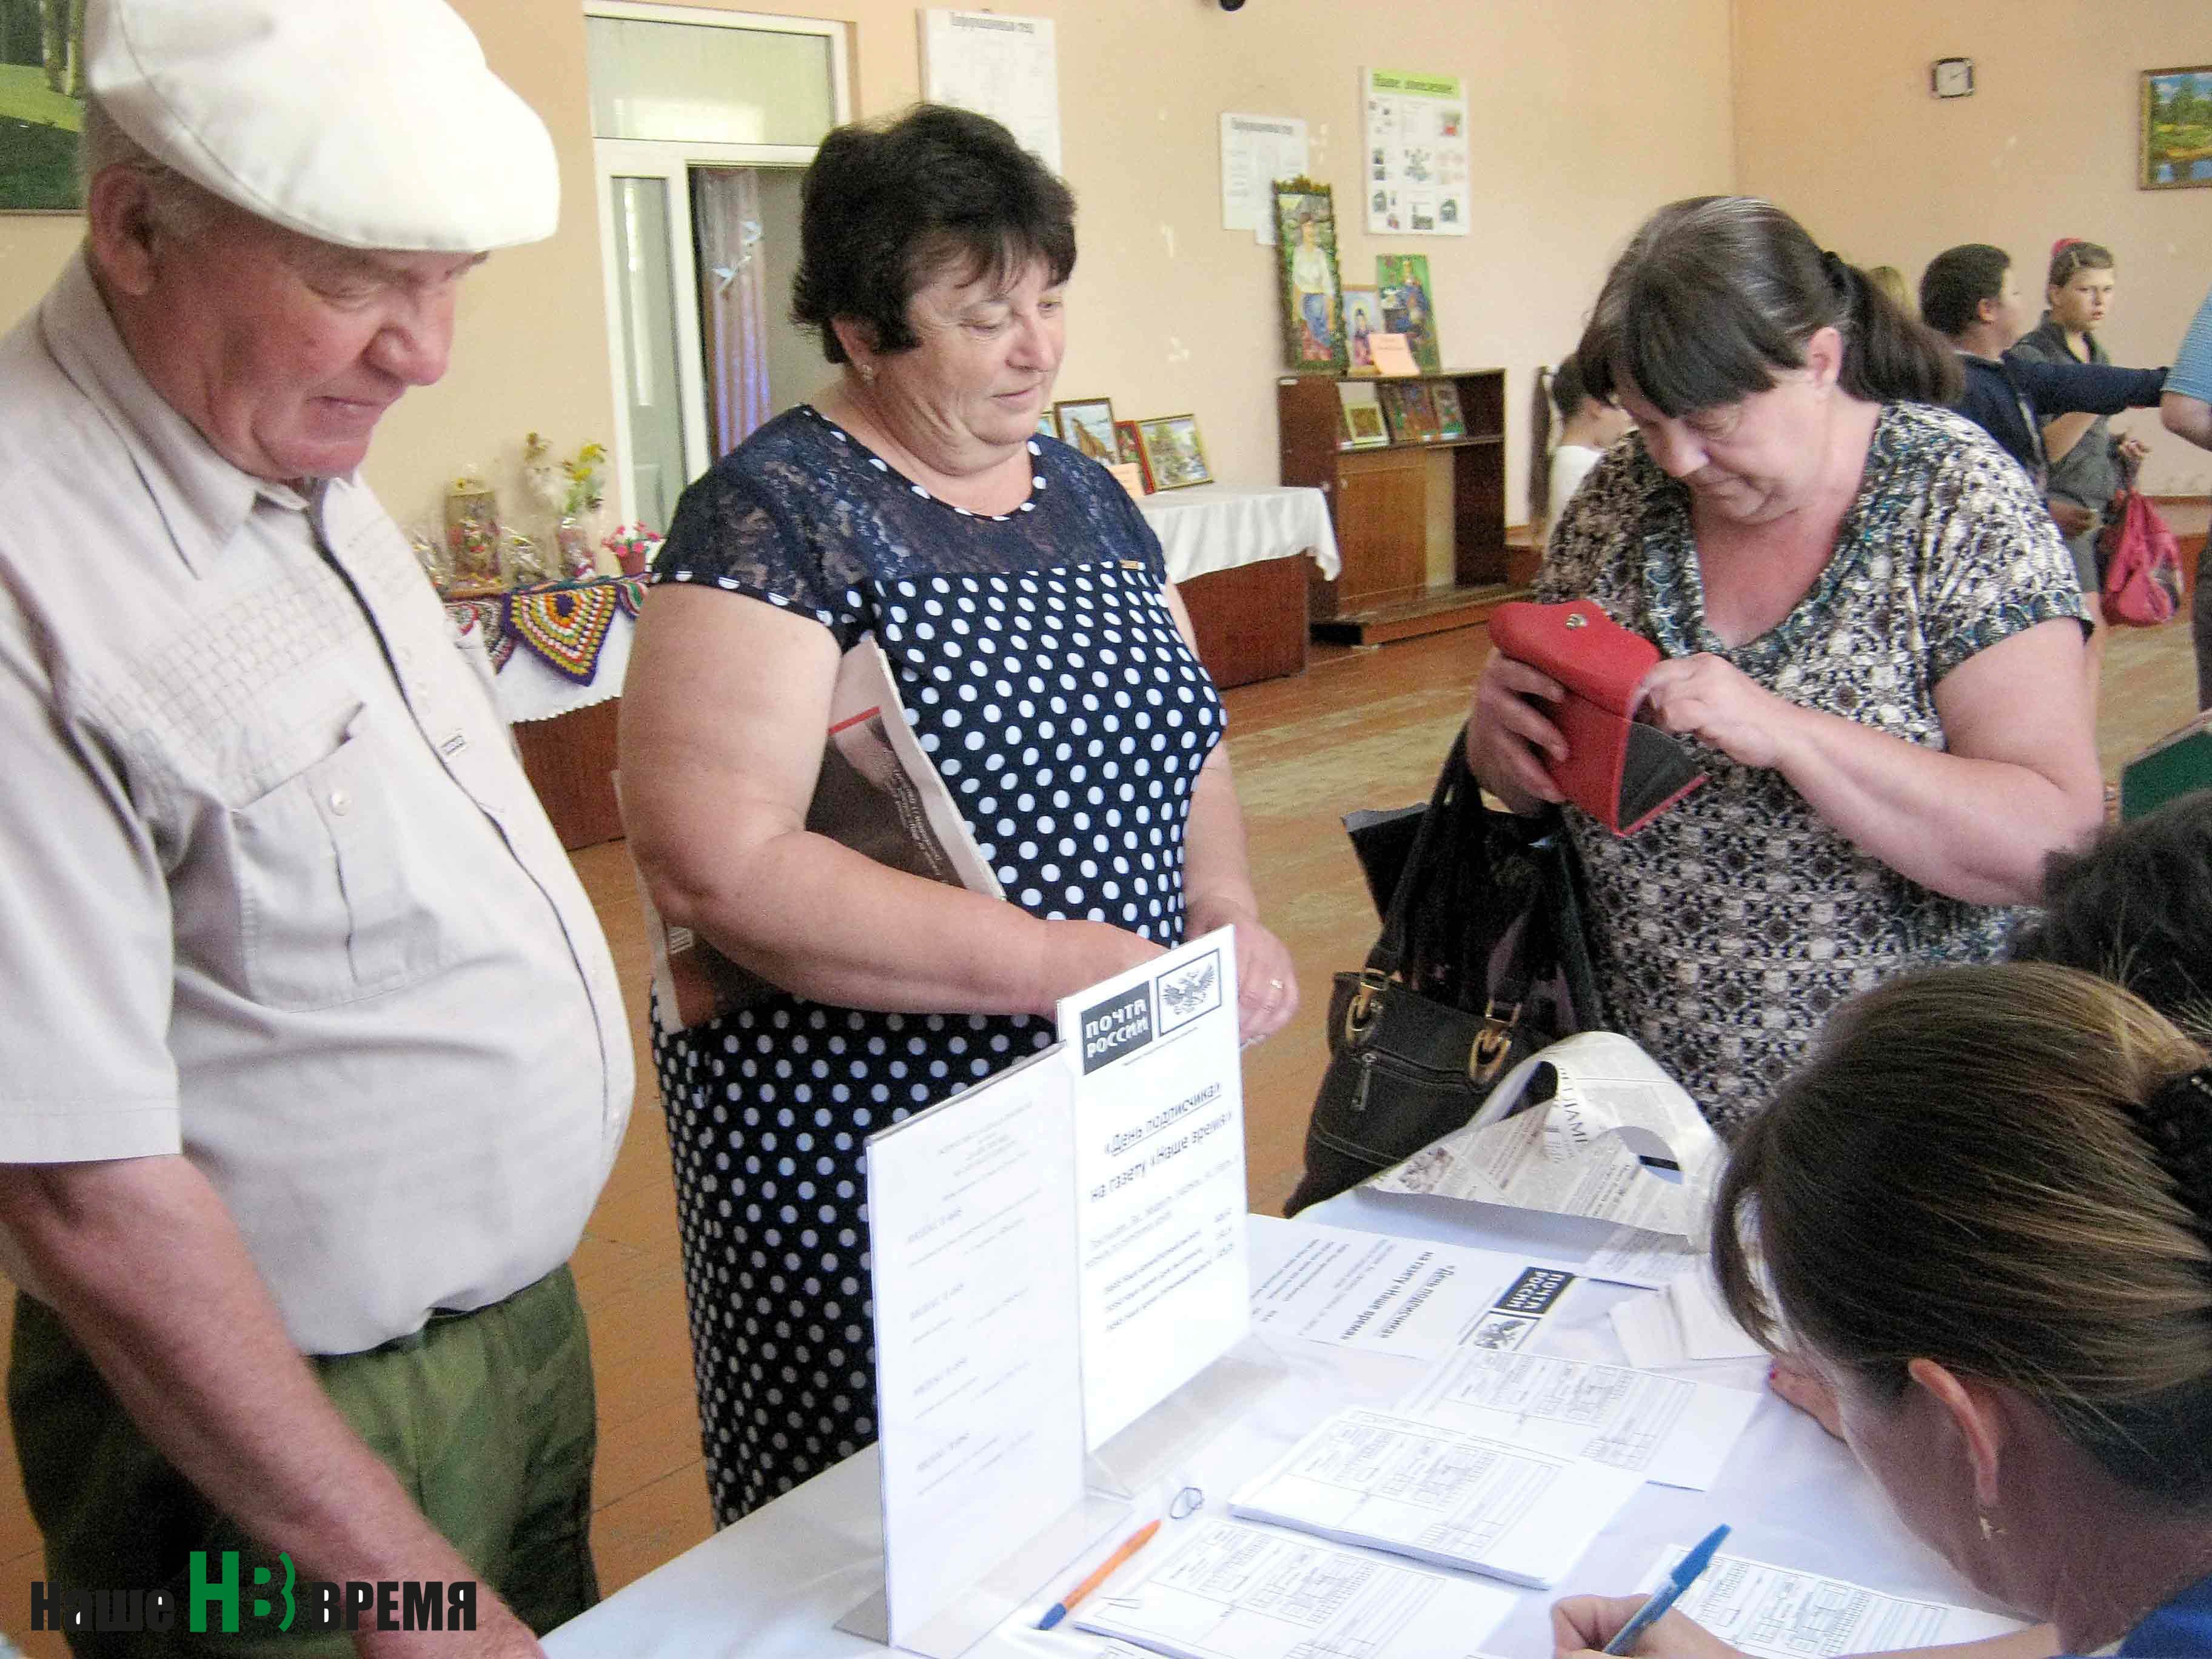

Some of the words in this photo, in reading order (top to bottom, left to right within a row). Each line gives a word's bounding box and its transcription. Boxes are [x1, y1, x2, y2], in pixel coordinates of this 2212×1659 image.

[1085, 999, 1147, 1038] ПОЧТА
[1087, 1017, 1150, 1058] РОССИИ
[1091, 1184, 1107, 1202] на
[1110, 1160, 1146, 1193] газету
[1392, 1261, 1426, 1285] газету
[1417, 1251, 1435, 1261] на
[1505, 1271, 1550, 1308] РОССИИ
[1523, 1273, 1565, 1310] ПОЧТА
